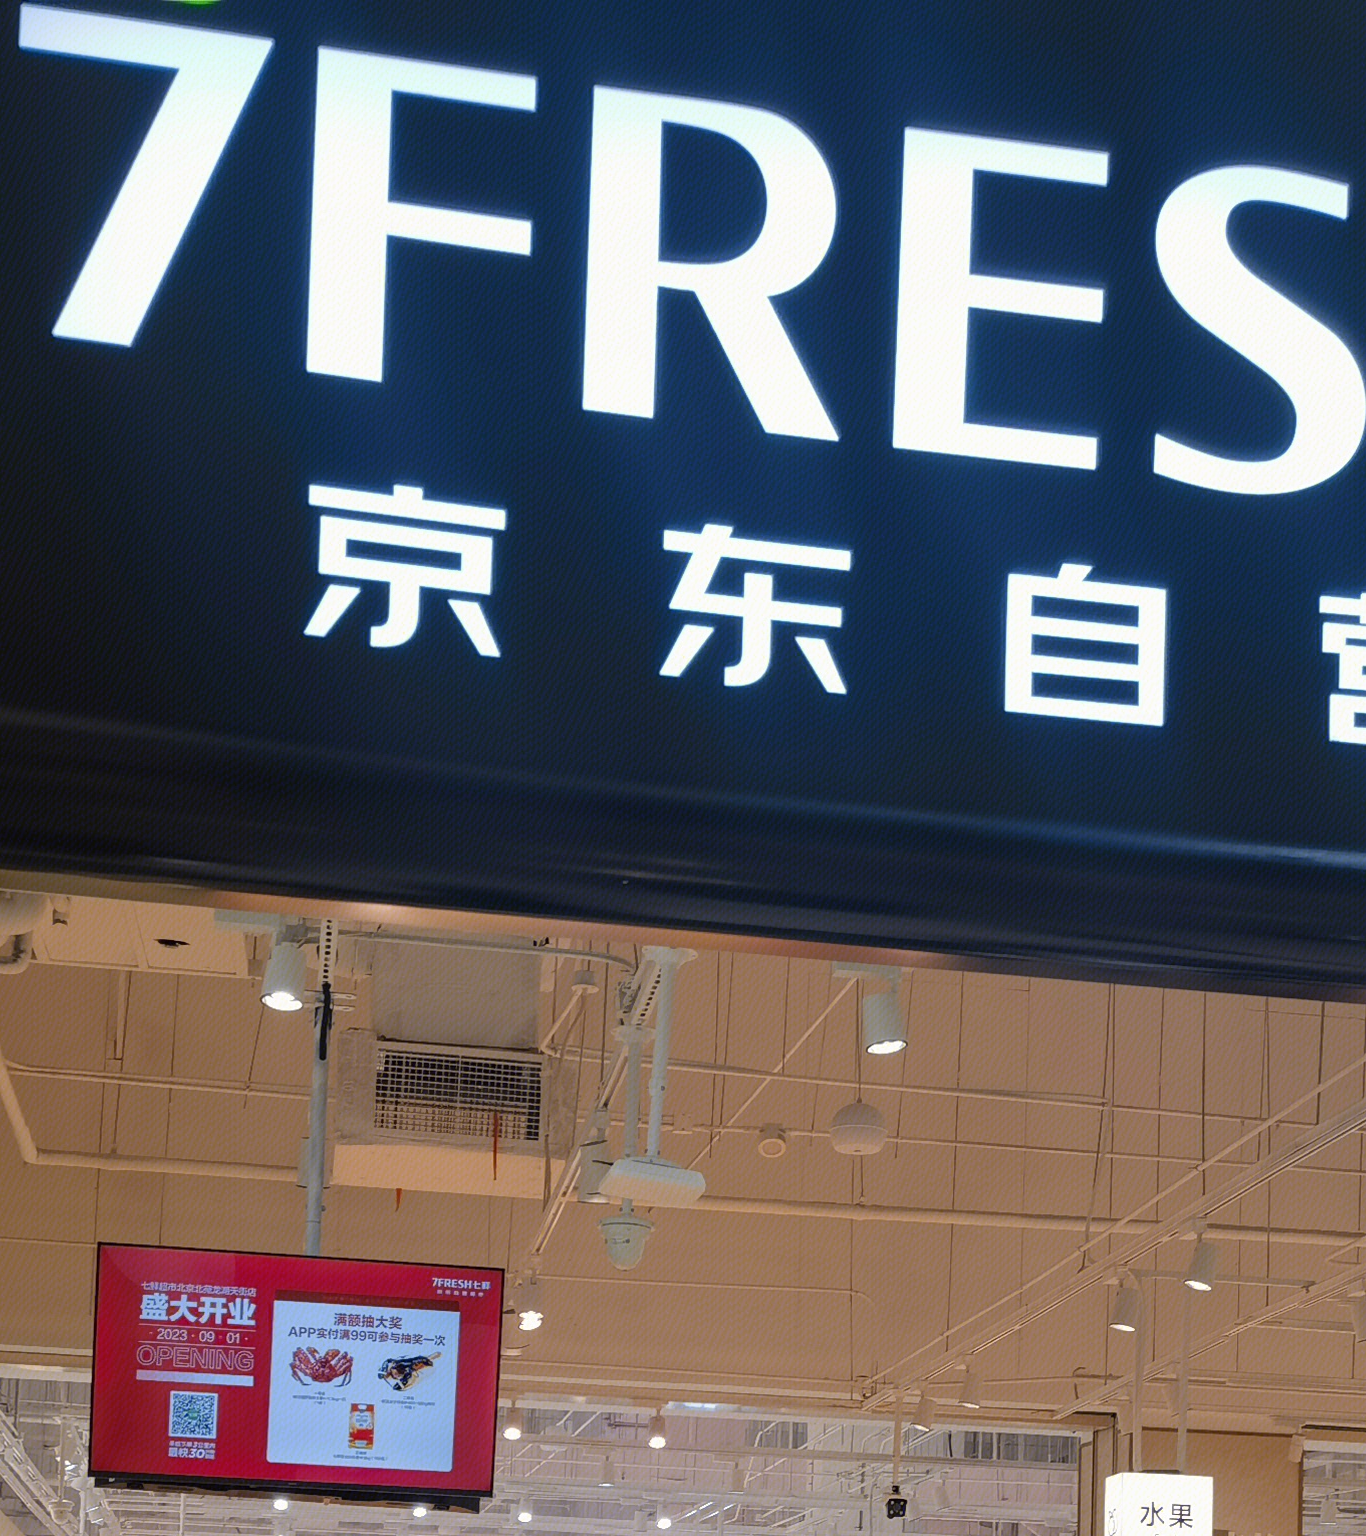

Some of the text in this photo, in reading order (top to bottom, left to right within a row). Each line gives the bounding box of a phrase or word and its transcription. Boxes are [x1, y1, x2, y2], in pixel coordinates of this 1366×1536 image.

[139, 1292, 257, 1326] 盛大开业
[333, 1312, 403, 1330] 满额抽大奖
[288, 1326, 446, 1347] APP实付满99可参与抽奖一次
[136, 1344, 255, 1372] OPENING
[1139, 1501, 1195, 1530] 水果
